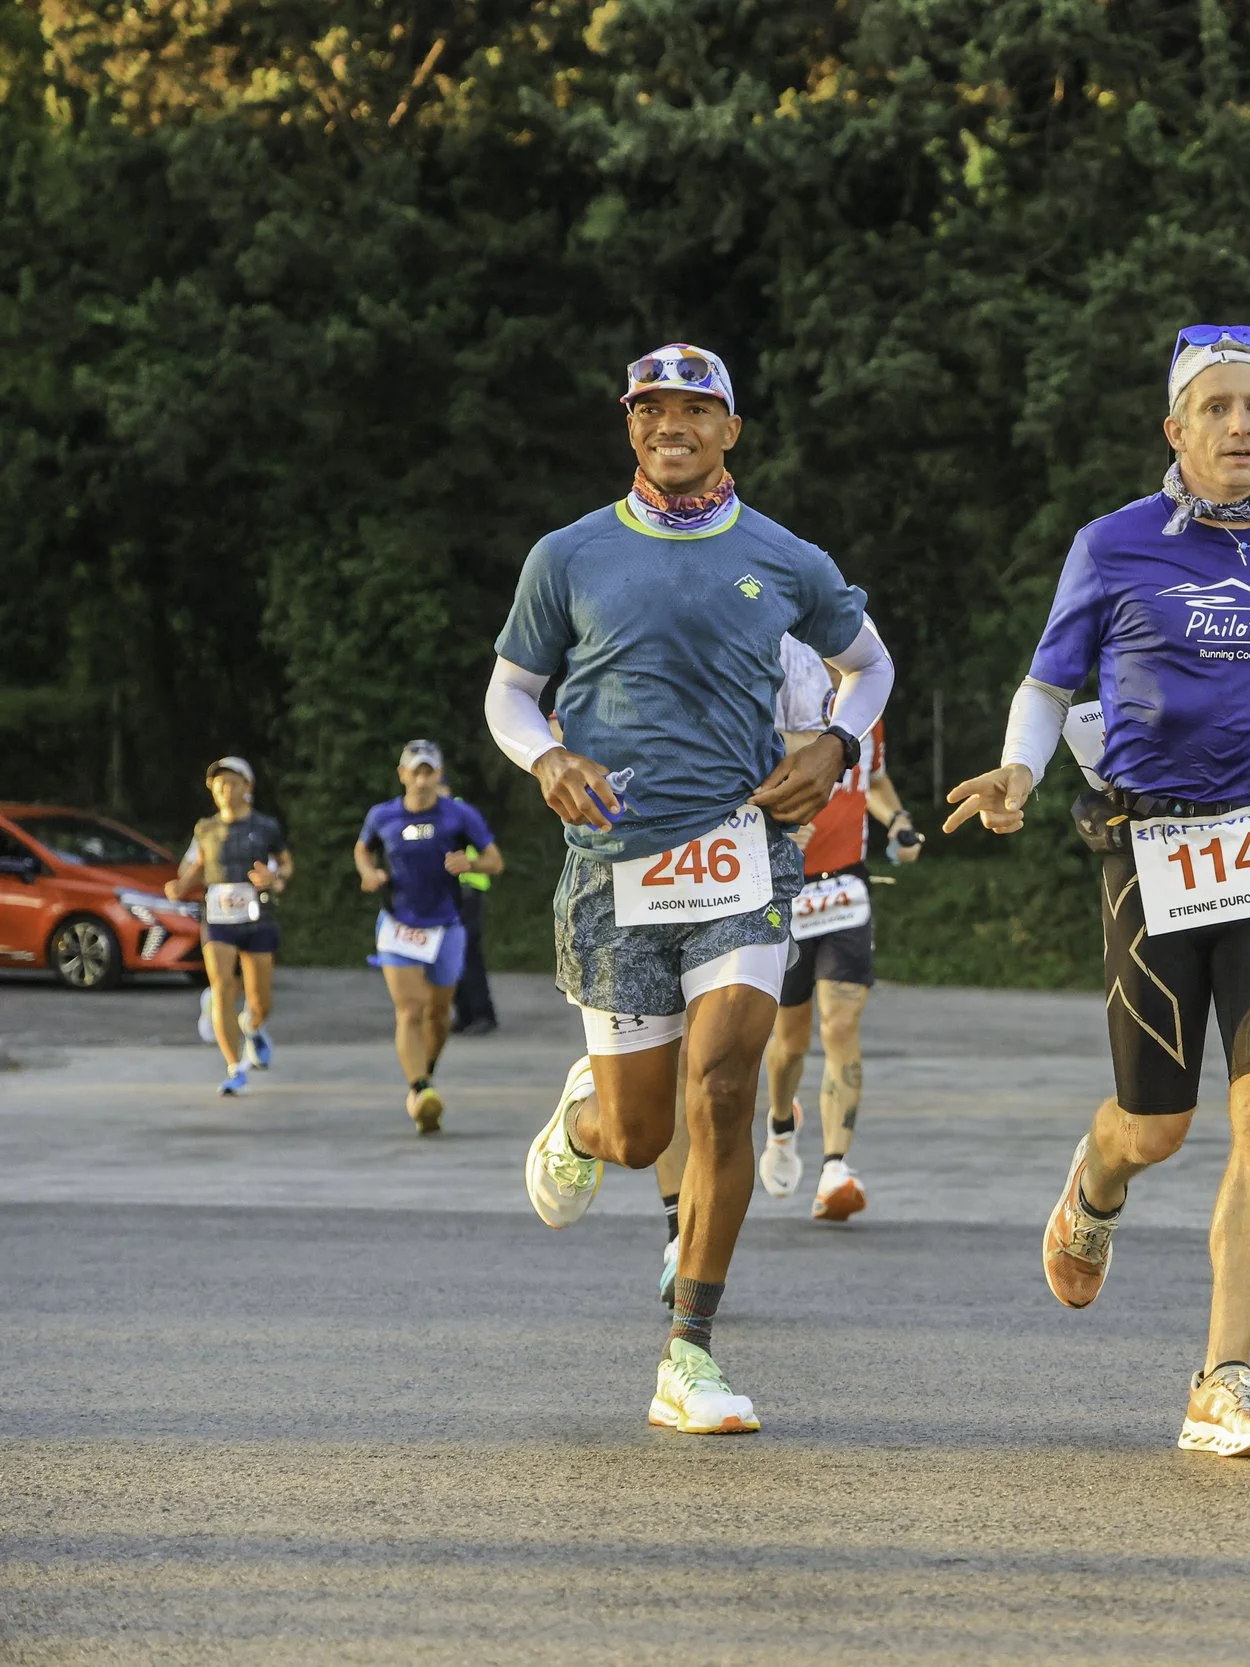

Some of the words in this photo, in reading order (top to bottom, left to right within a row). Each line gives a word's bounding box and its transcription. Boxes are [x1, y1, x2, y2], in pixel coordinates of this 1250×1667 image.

[1199, 649, 1235, 661] Running
[1079, 711, 1104, 723] HER
[641, 838, 741, 887] 246
[647, 899, 685, 911] JASON
[687, 893, 741, 909] WILLIAMS
[1169, 900, 1218, 918] ETIENNE
